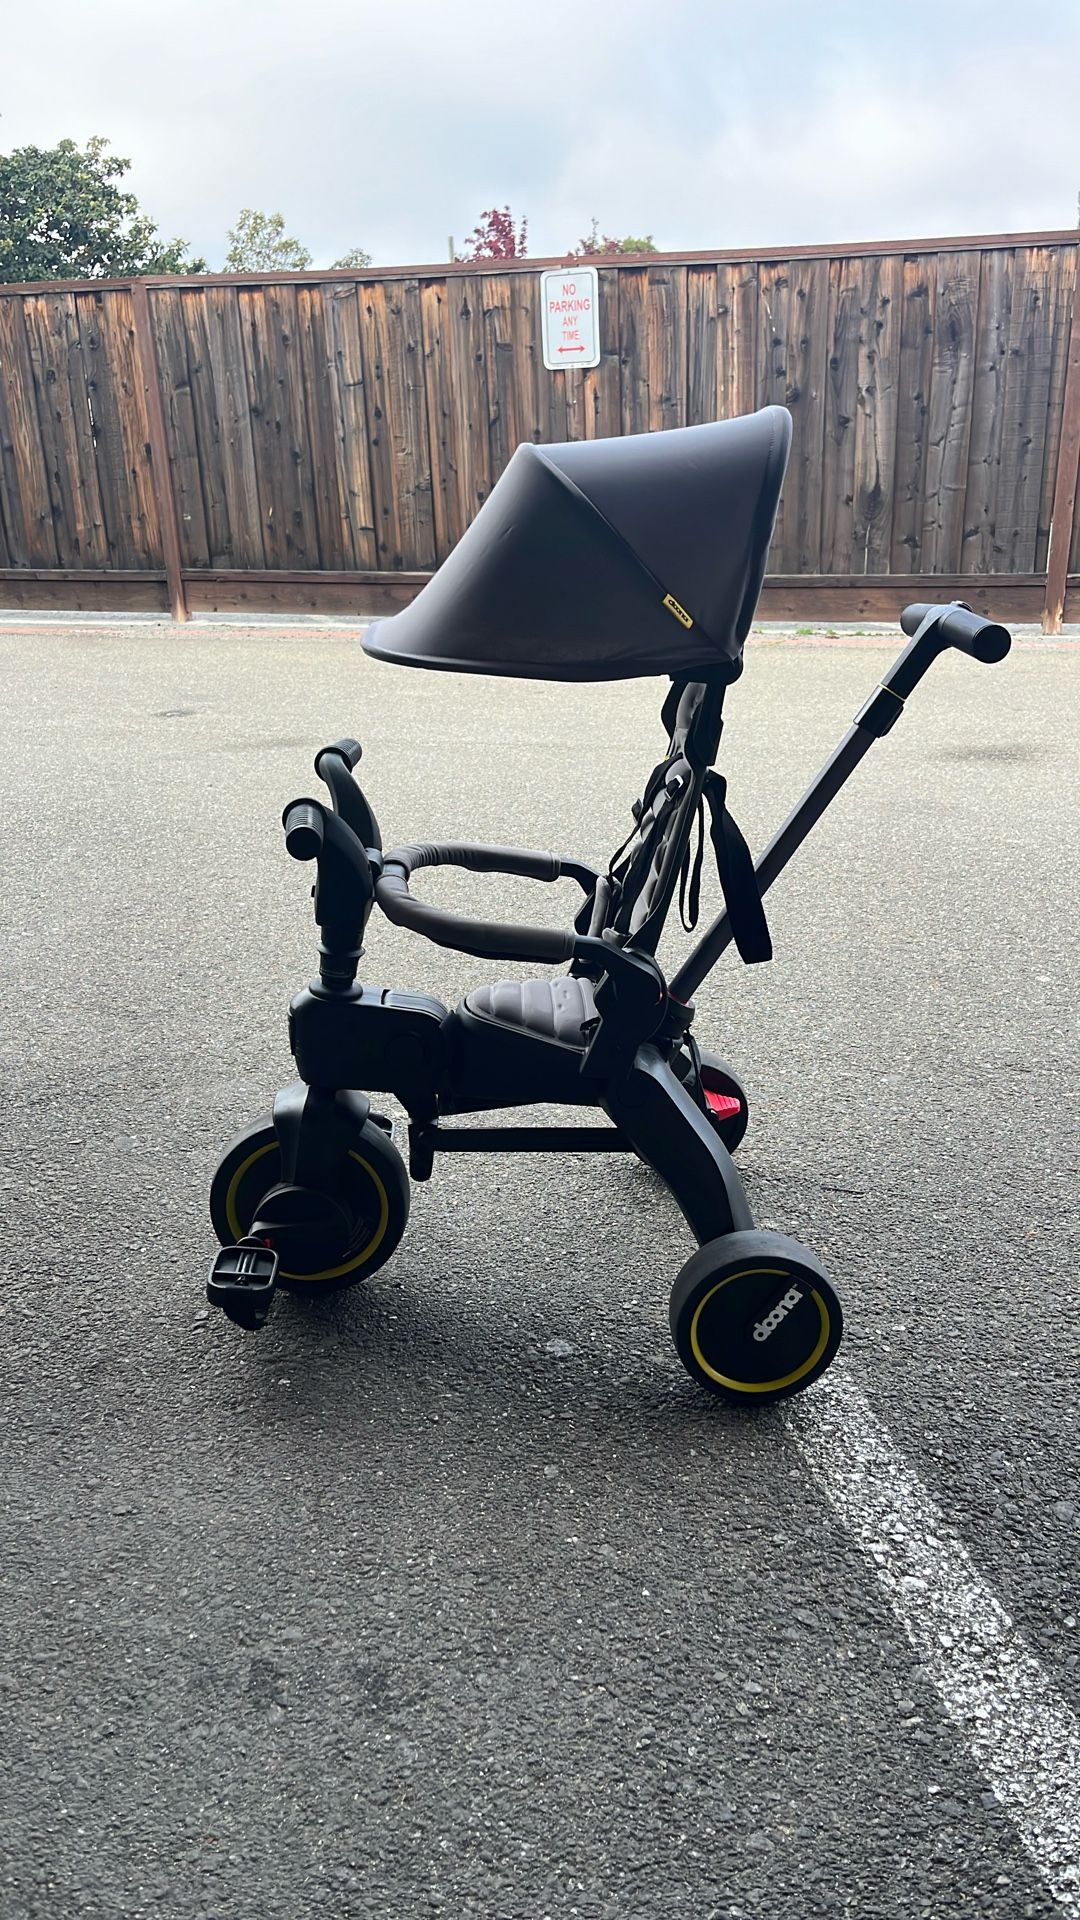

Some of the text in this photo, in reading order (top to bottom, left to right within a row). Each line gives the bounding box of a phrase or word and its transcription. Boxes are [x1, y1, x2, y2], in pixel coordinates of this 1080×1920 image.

[562, 284, 576, 296] NO
[549, 299, 591, 312] PARKING
[562, 316, 577, 326] ANY
[562, 330, 580, 340] TIME
[753, 1287, 803, 1341] doona
